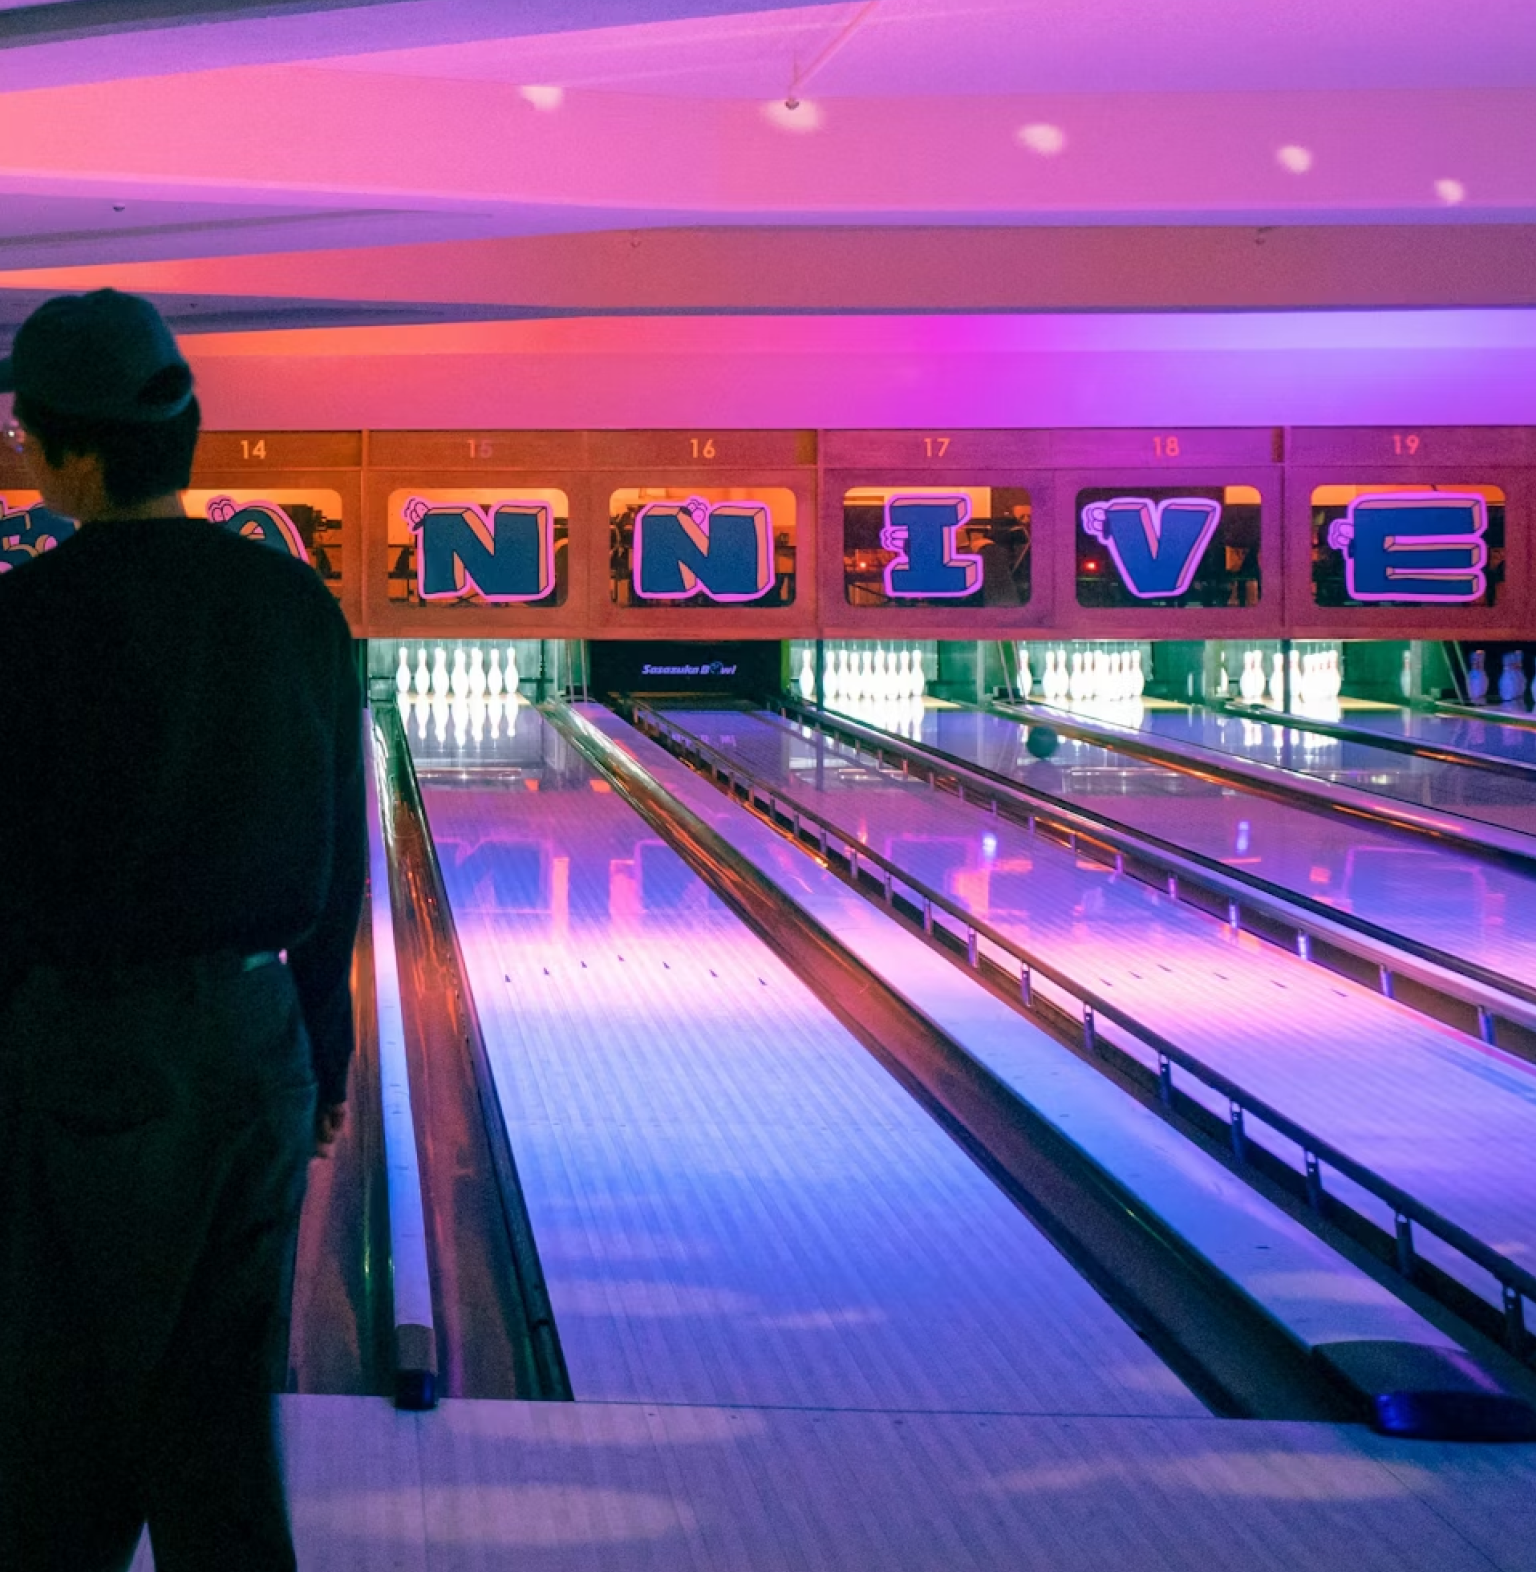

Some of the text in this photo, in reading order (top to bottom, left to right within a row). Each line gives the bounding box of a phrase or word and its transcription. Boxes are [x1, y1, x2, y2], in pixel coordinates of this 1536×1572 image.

[240, 439, 267, 460] 14
[467, 439, 493, 459] 15
[690, 438, 716, 459] 16
[924, 437, 951, 457] 17
[1153, 436, 1180, 457] 18
[1393, 434, 1420, 455] 19
